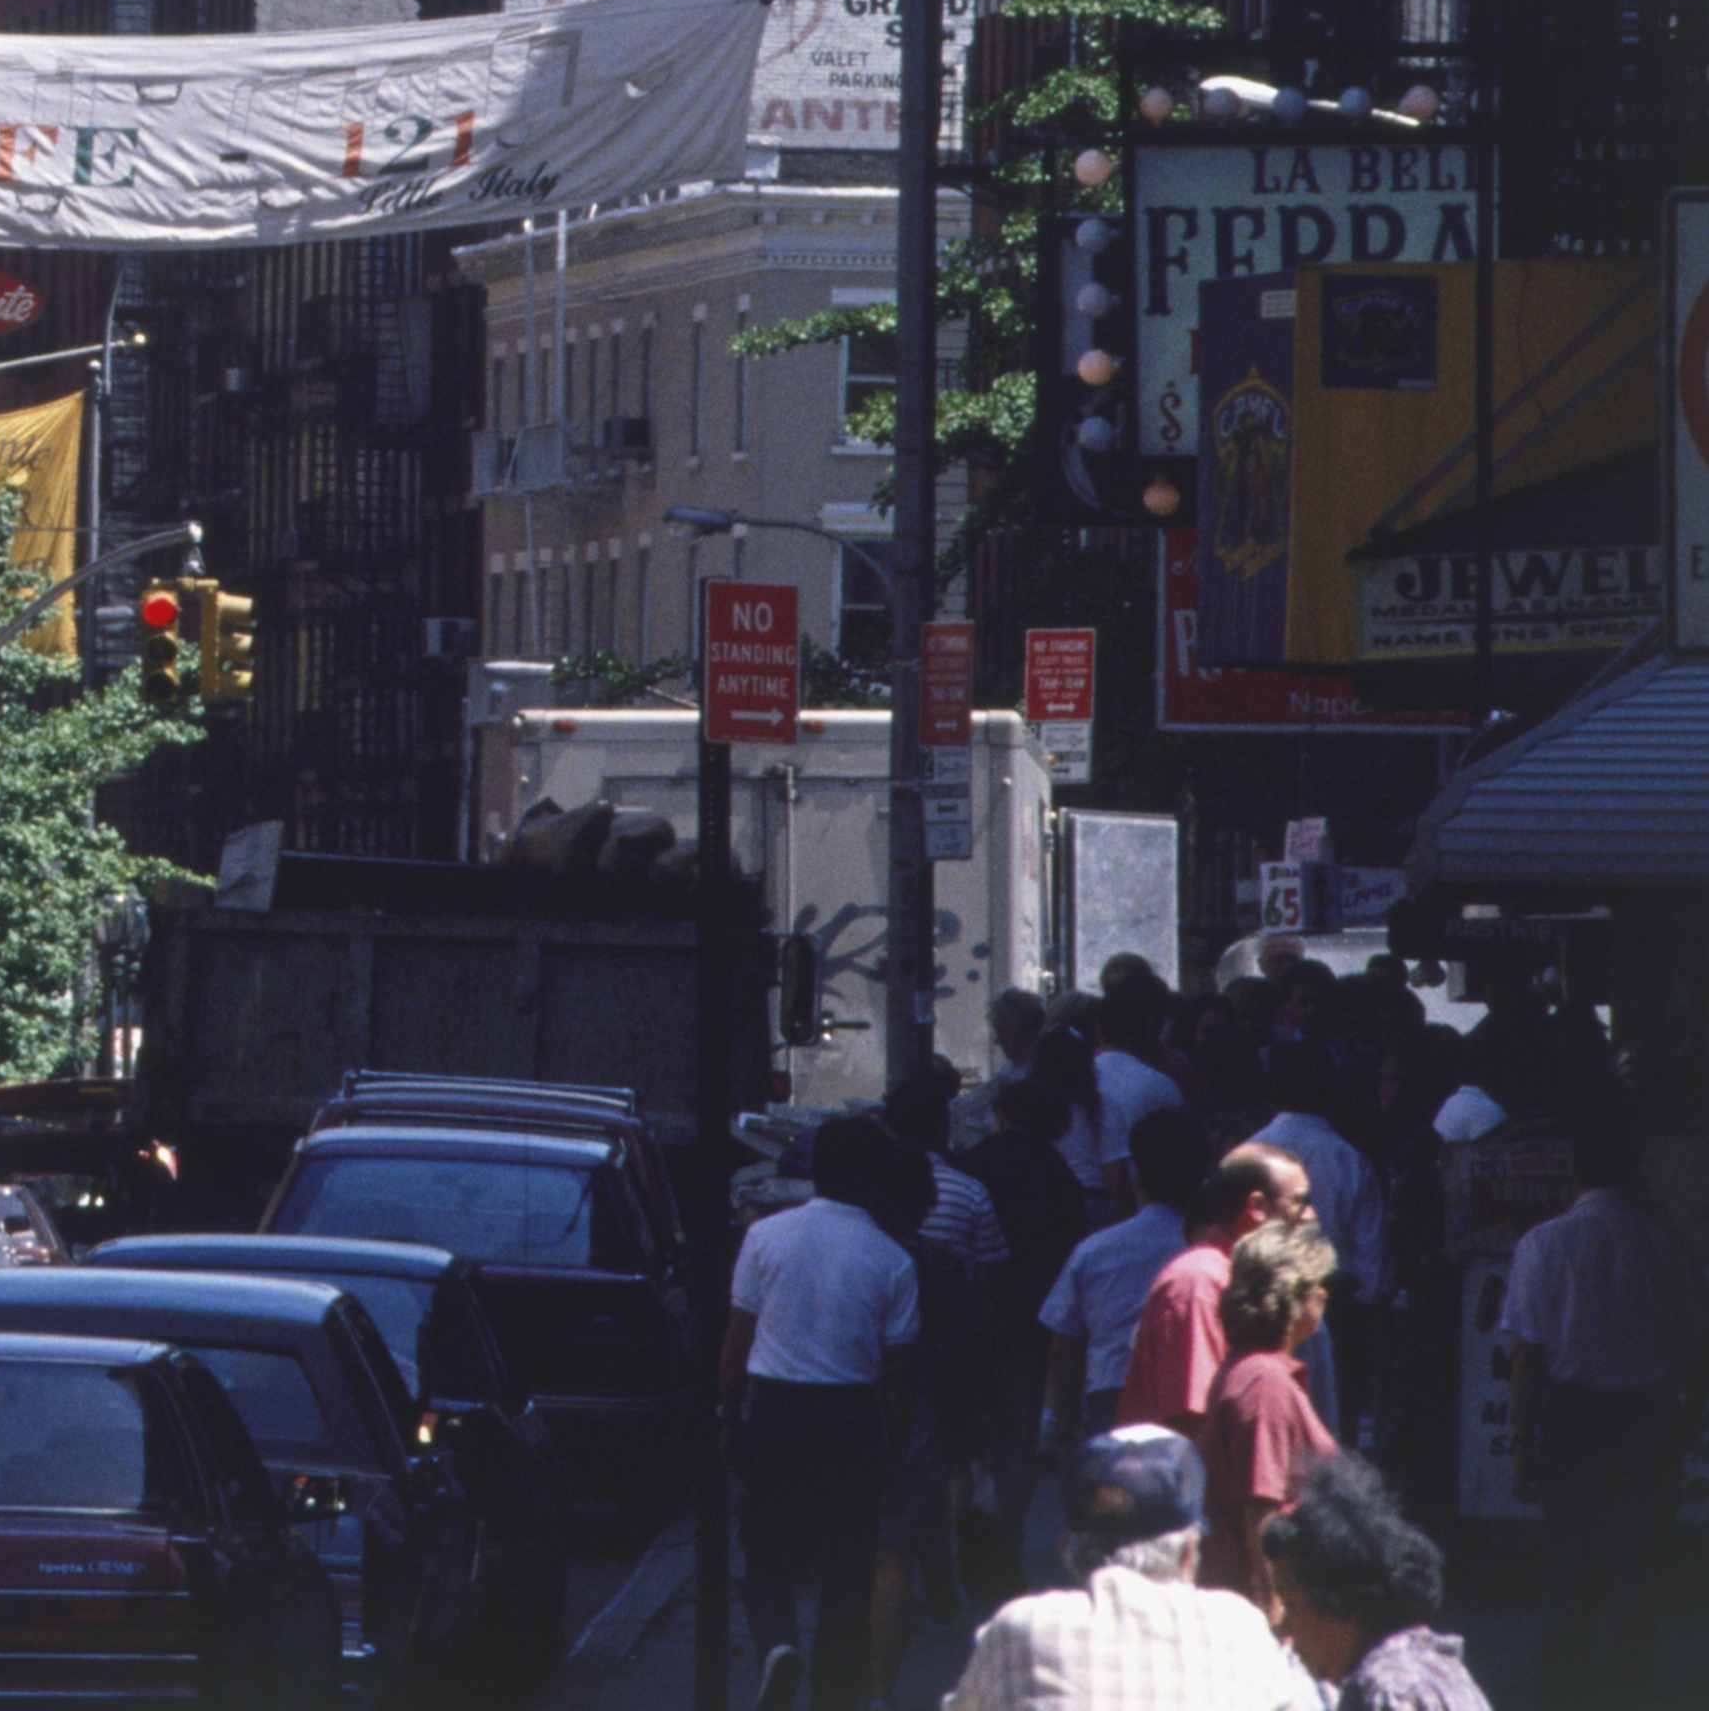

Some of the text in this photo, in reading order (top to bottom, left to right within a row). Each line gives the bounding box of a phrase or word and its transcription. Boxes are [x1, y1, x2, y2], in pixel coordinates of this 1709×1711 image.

[811, 50, 870, 68] VALET
[336, 109, 479, 178] 121
[1252, 148, 1321, 193] LA
[358, 161, 561, 213] Little Italy
[732, 602, 774, 634] NO
[711, 641, 797, 667] STANDING
[1033, 640, 1089, 653] NO STANDING
[716, 673, 791, 699] ANYTIME
